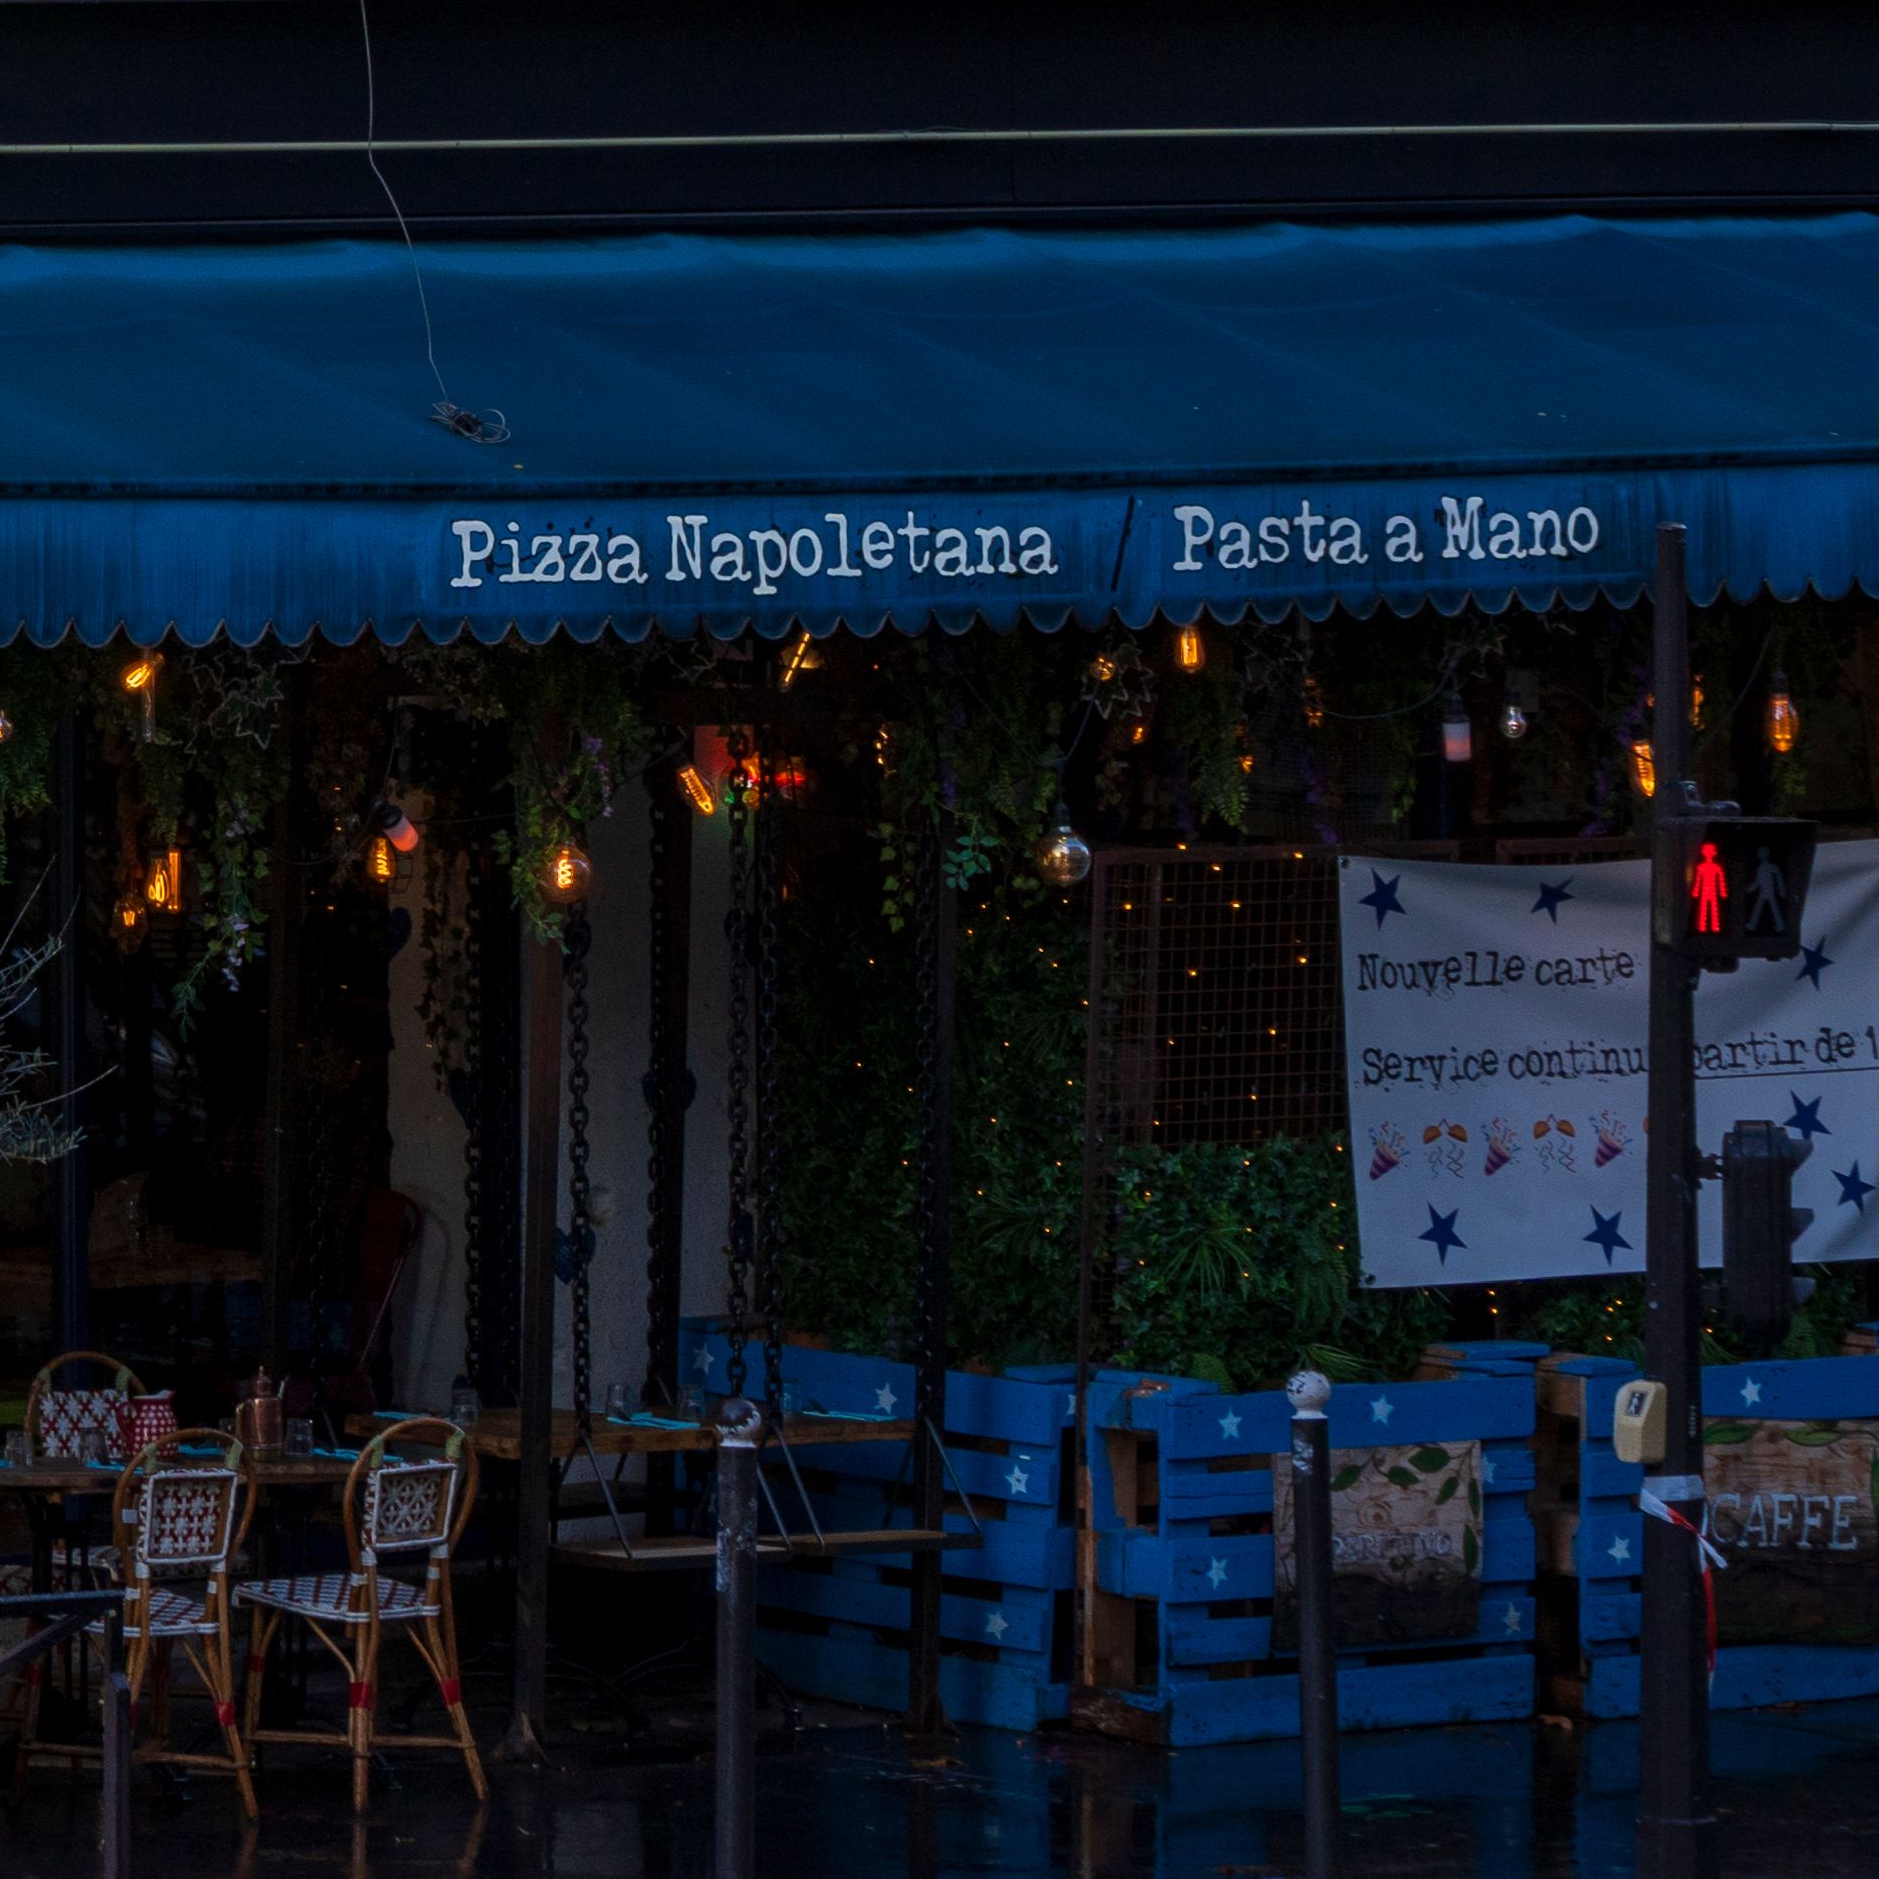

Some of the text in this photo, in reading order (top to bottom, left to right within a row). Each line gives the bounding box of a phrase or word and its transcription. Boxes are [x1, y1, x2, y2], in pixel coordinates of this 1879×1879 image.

[449, 511, 1060, 597] Pizza Napoletana
[1172, 494, 1601, 572] Pasta a Mano
[1357, 948, 1637, 993] Nouvelle carte
[1362, 1046, 1500, 1087] Service
[1508, 1040, 1646, 1080] continu
[1818, 1026, 1856, 1064] de
[1711, 1491, 1859, 1551] CAFFE
